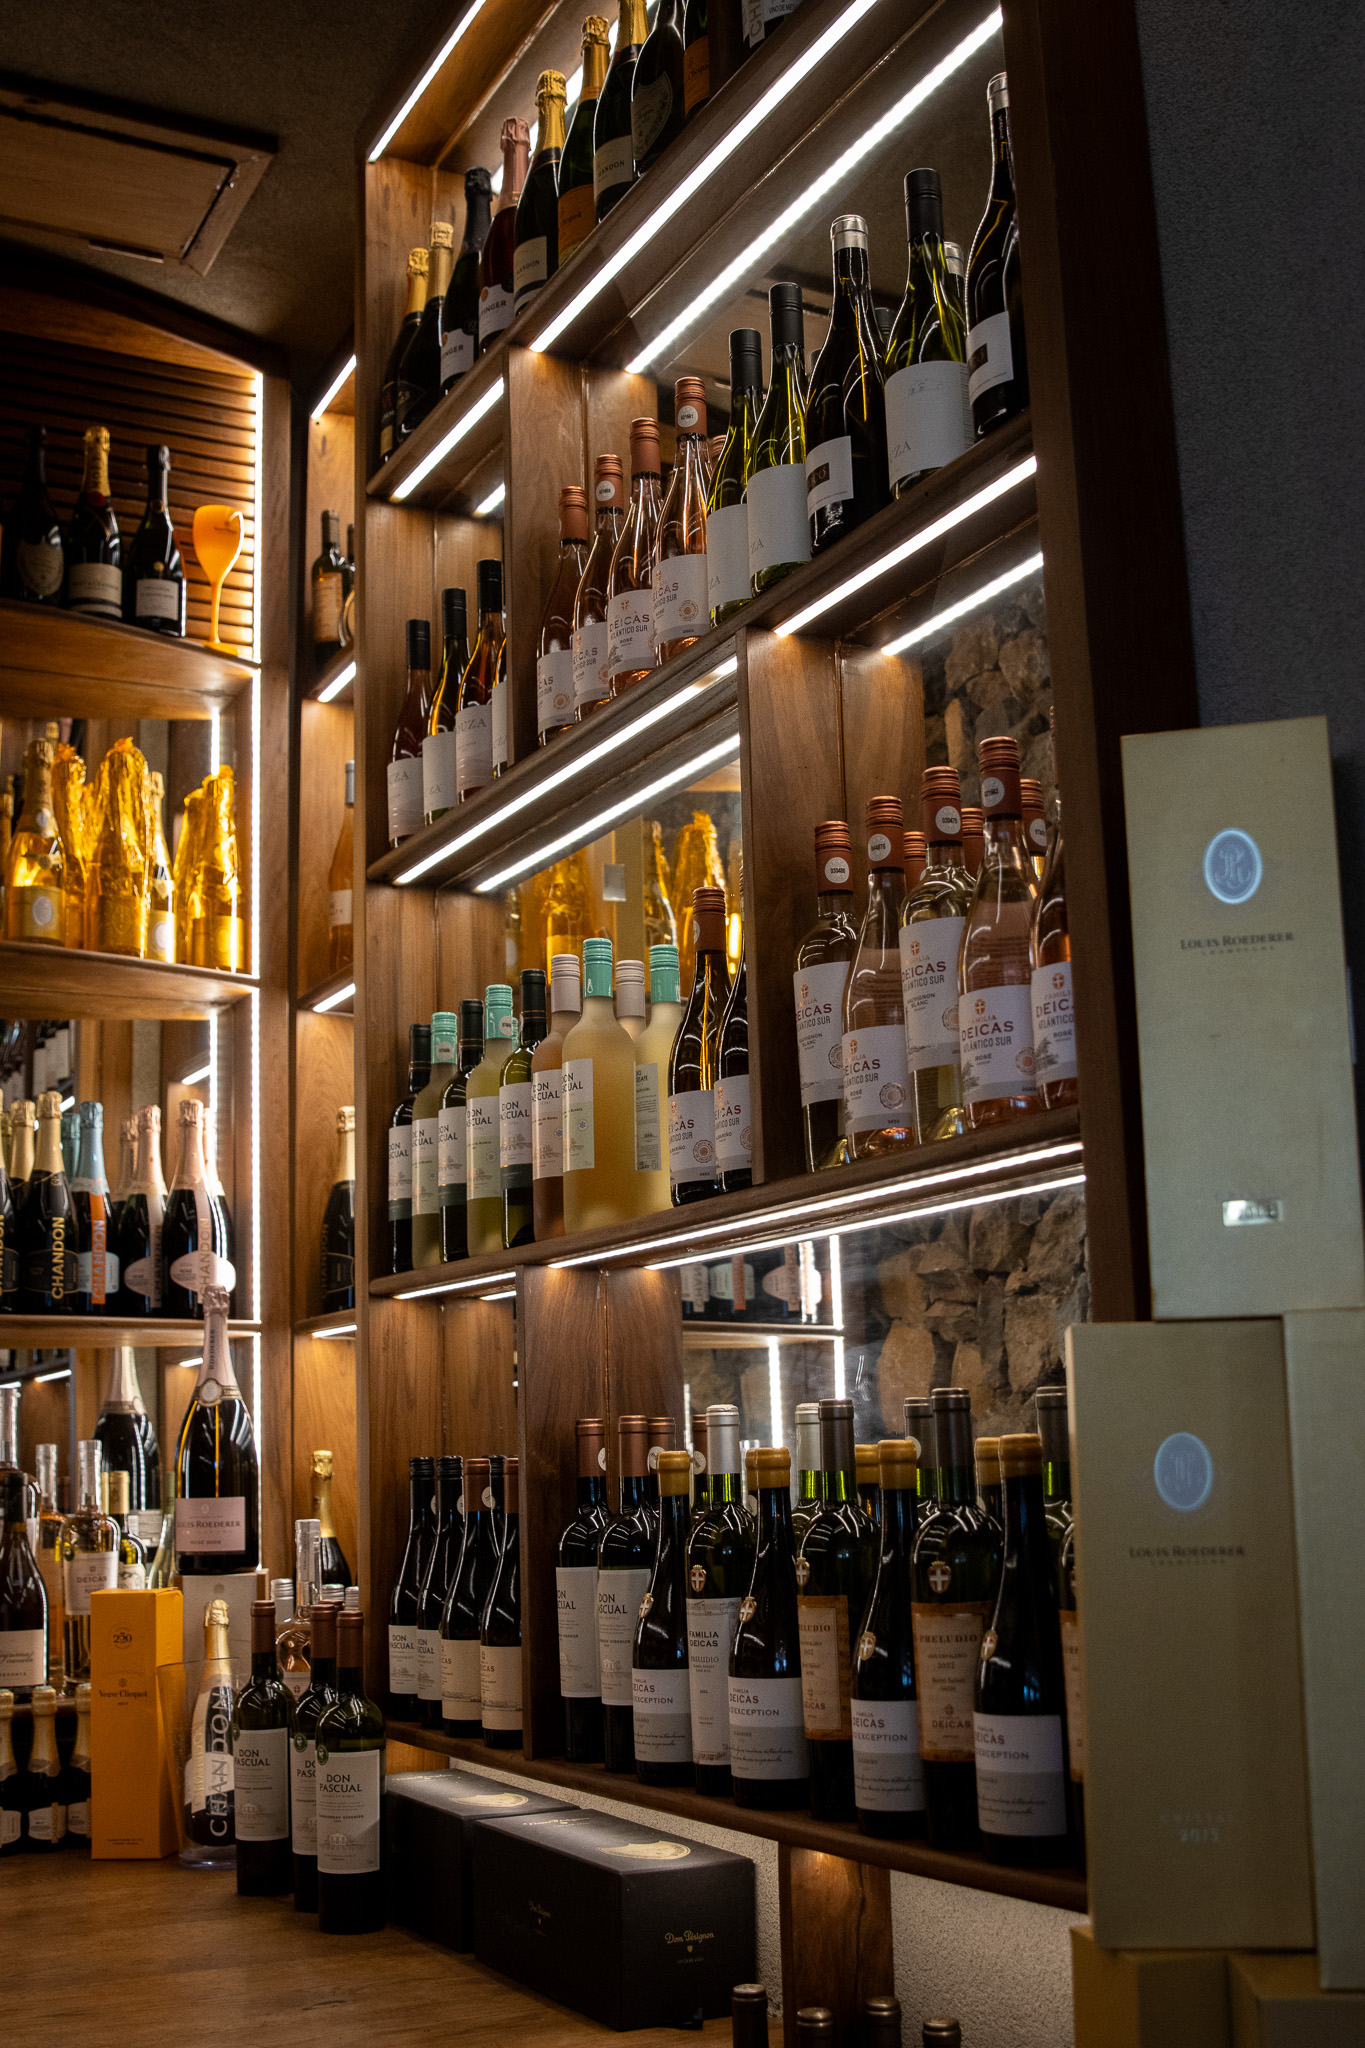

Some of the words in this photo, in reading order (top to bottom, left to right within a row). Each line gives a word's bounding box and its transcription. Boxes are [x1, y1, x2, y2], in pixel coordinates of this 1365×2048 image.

[610, 614, 650, 631] DEICAS
[635, 624, 648, 633] SUR
[1180, 938, 1219, 950] LOUIS
[1222, 931, 1294, 946] ROEDERER
[929, 974, 945, 985] SUR
[816, 1015, 830, 1025] SUR
[961, 1021, 1014, 1041] DEICAS
[995, 1035, 1012, 1046] SUR
[865, 1073, 879, 1082] SUR
[502, 1101, 519, 1111] DON
[728, 1117, 740, 1126] SUR
[682, 1131, 693, 1140] SUR
[51, 1216, 65, 1299] CHANDON
[92, 1219, 105, 1299] CHANDON
[196, 1519, 241, 1528] ROEDERER
[1129, 1547, 1169, 1557] LOUIS
[1172, 1545, 1244, 1557] ROEDERER
[77, 1575, 107, 1583] DEICAS
[599, 1594, 615, 1603] DON
[690, 1639, 718, 1647] DEICAS
[919, 1634, 977, 1643] PRELUDIO
[99, 1689, 119, 1698] Veuve
[119, 1688, 148, 1700] Clicquot
[932, 1719, 971, 1729] DEICAS
[239, 1749, 259, 1757] DON
[209, 1692, 230, 1838] CHANDON
[304, 1760, 316, 1768] DO
[296, 1770, 316, 1778] PASC
[326, 1774, 351, 1783] DON
[319, 1783, 363, 1793] PASCUAL
[664, 1932, 684, 1944] Dom
[684, 1929, 715, 1944] Pérignon
